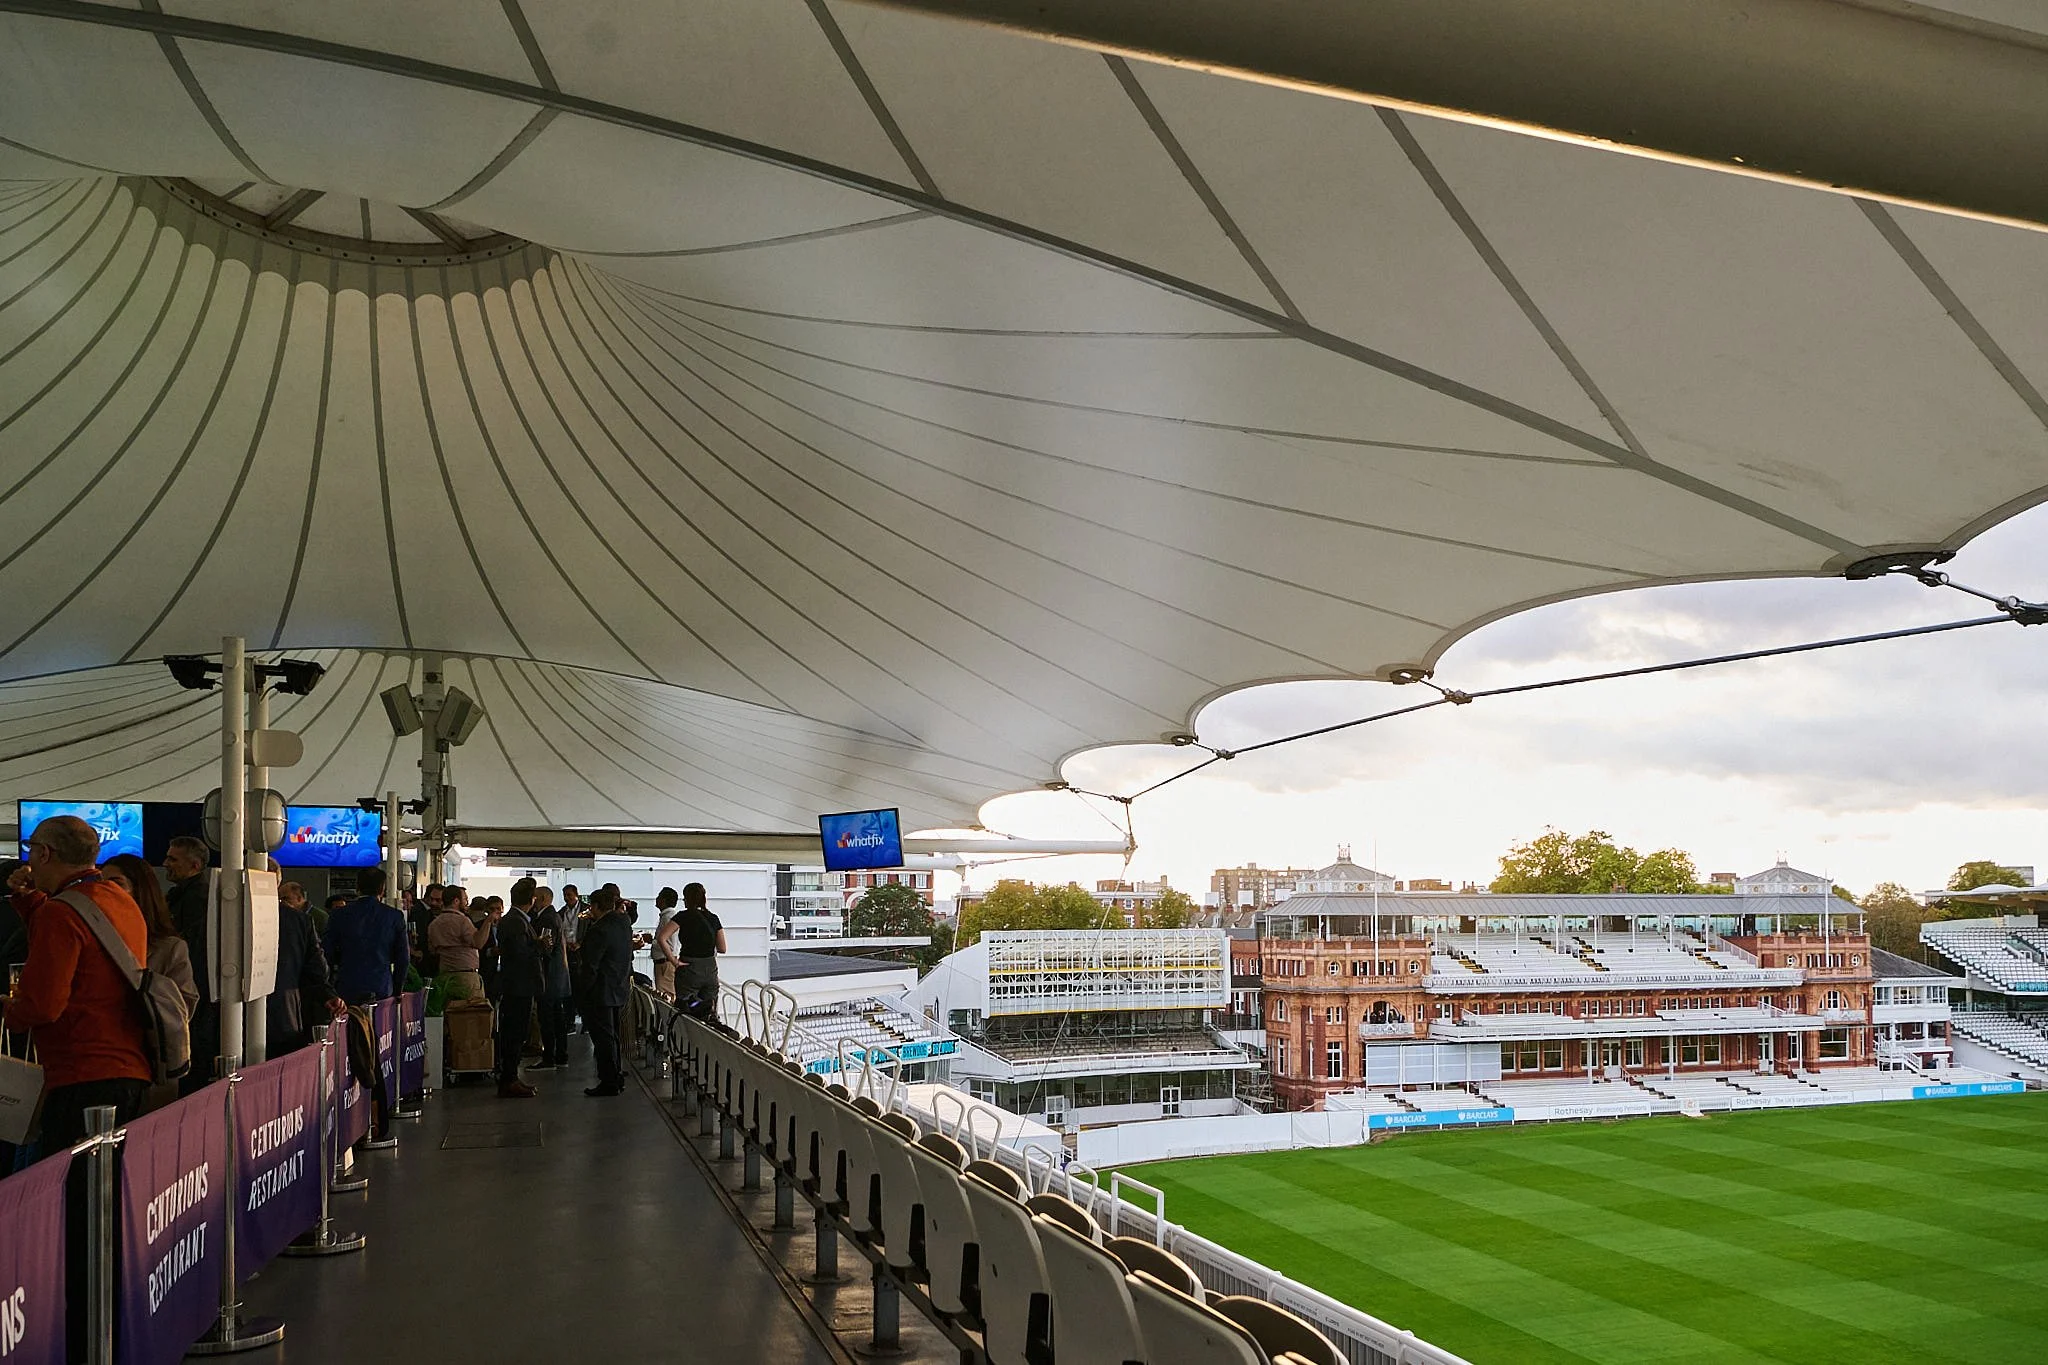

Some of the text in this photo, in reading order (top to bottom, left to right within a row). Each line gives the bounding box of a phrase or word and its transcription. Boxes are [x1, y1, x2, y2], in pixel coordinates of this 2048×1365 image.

[304, 831, 360, 846] whatfix
[846, 834, 884, 848] whatfix
[1466, 1110, 1499, 1120] BARCLAYS
[1554, 1106, 1593, 1116] Rothesay
[1393, 1114, 1427, 1124] BARCLAYS
[251, 1105, 304, 1160] CENTURIONS
[247, 1150, 305, 1211] RESTAURANT
[146, 1161, 209, 1245] CENTURIONS
[149, 1221, 208, 1316] RESTAURANT
